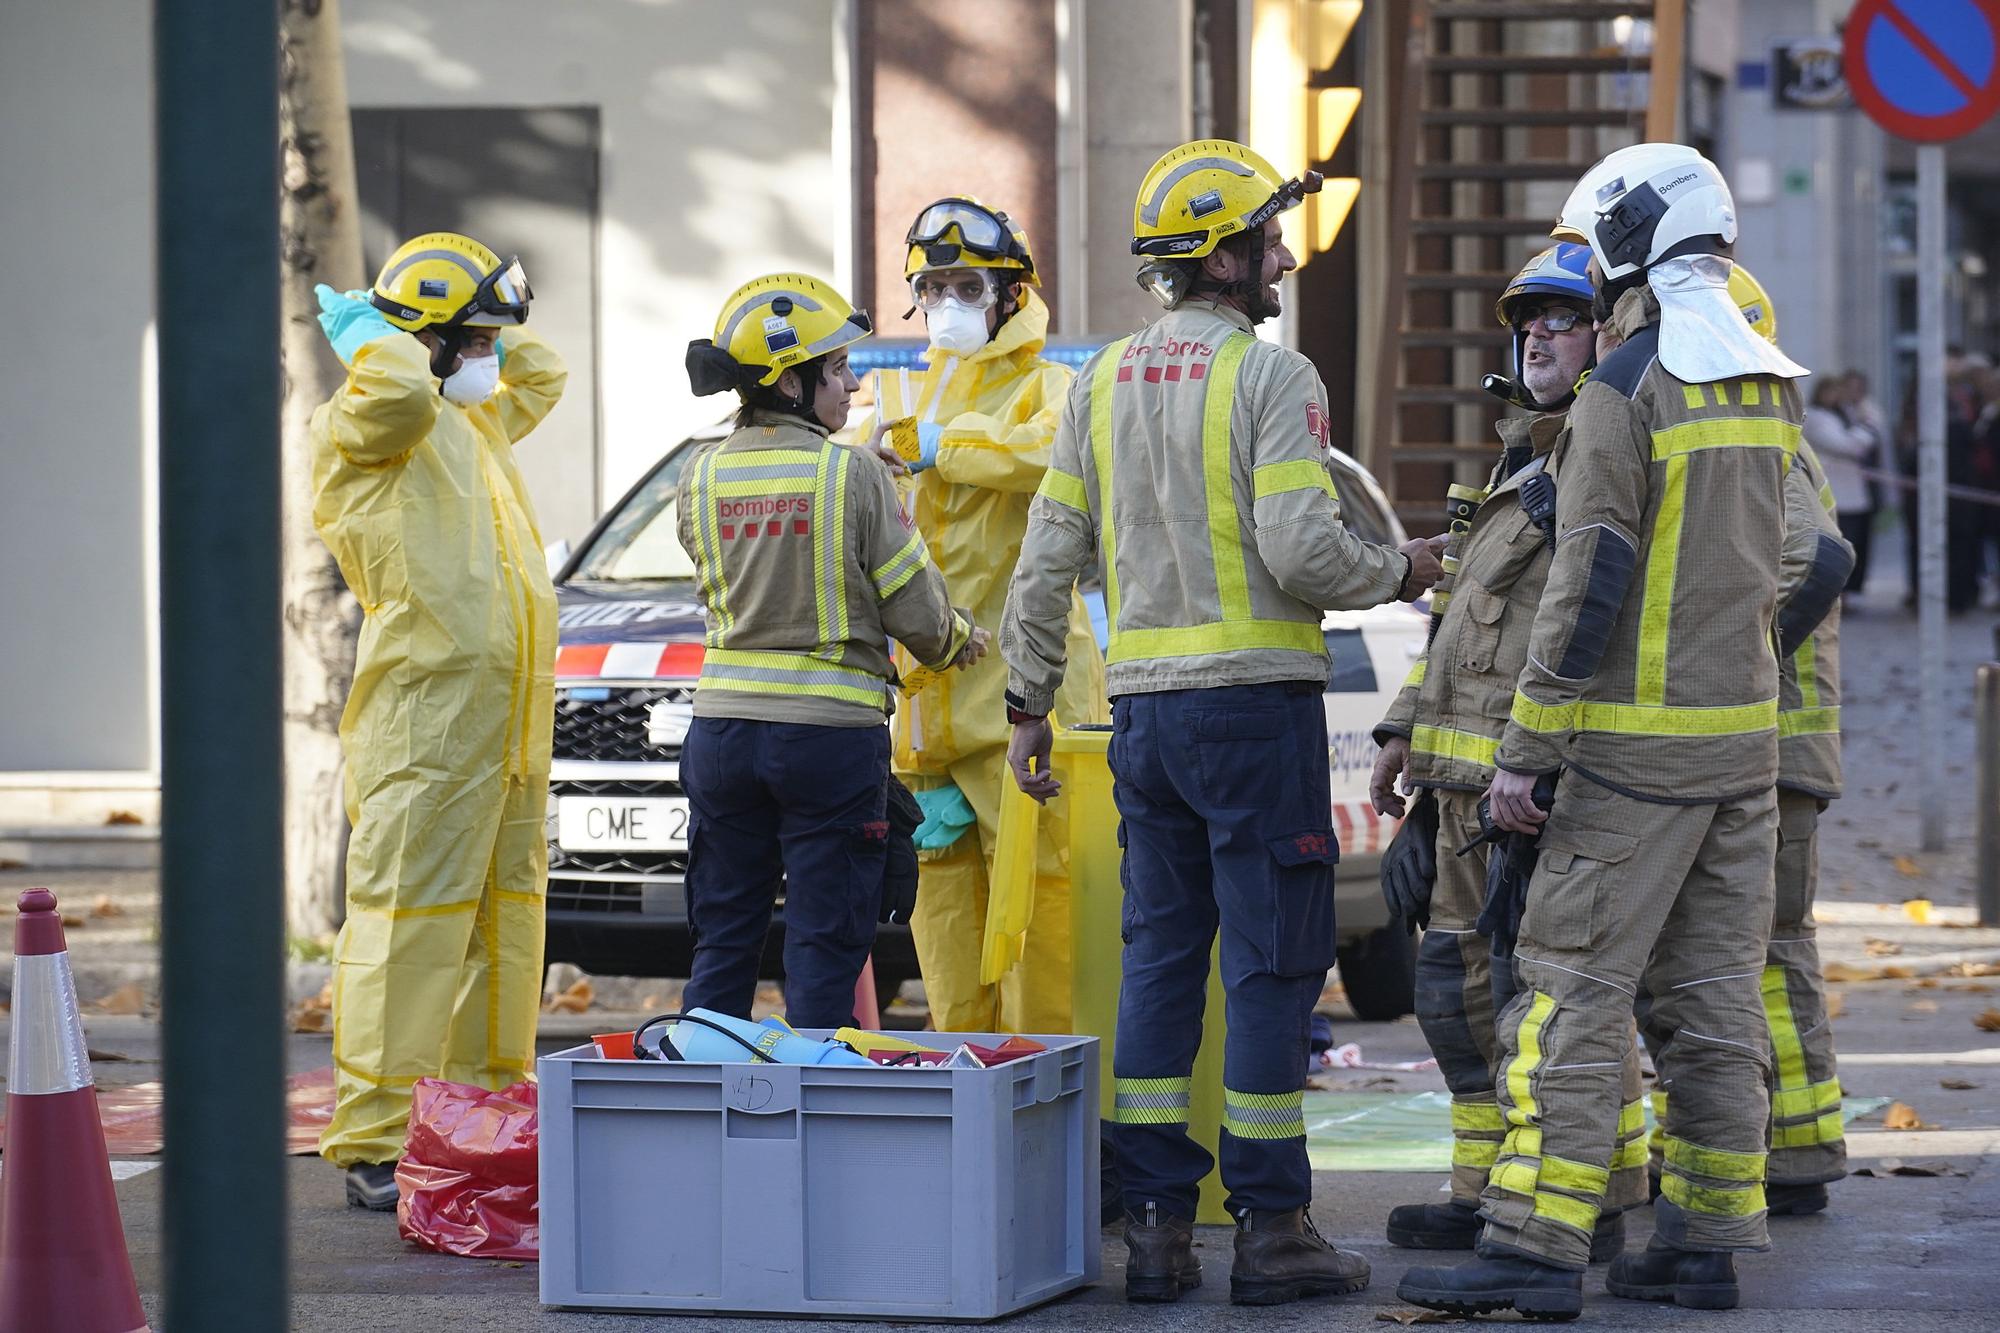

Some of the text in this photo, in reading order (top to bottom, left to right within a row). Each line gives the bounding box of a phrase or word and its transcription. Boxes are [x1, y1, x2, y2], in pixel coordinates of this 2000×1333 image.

[1658, 172, 1698, 195] Bombers
[1169, 239, 1203, 252] 3M
[1123, 336, 1213, 361] bobers
[720, 497, 809, 518] bombers
[587, 807, 687, 840] CME 2
